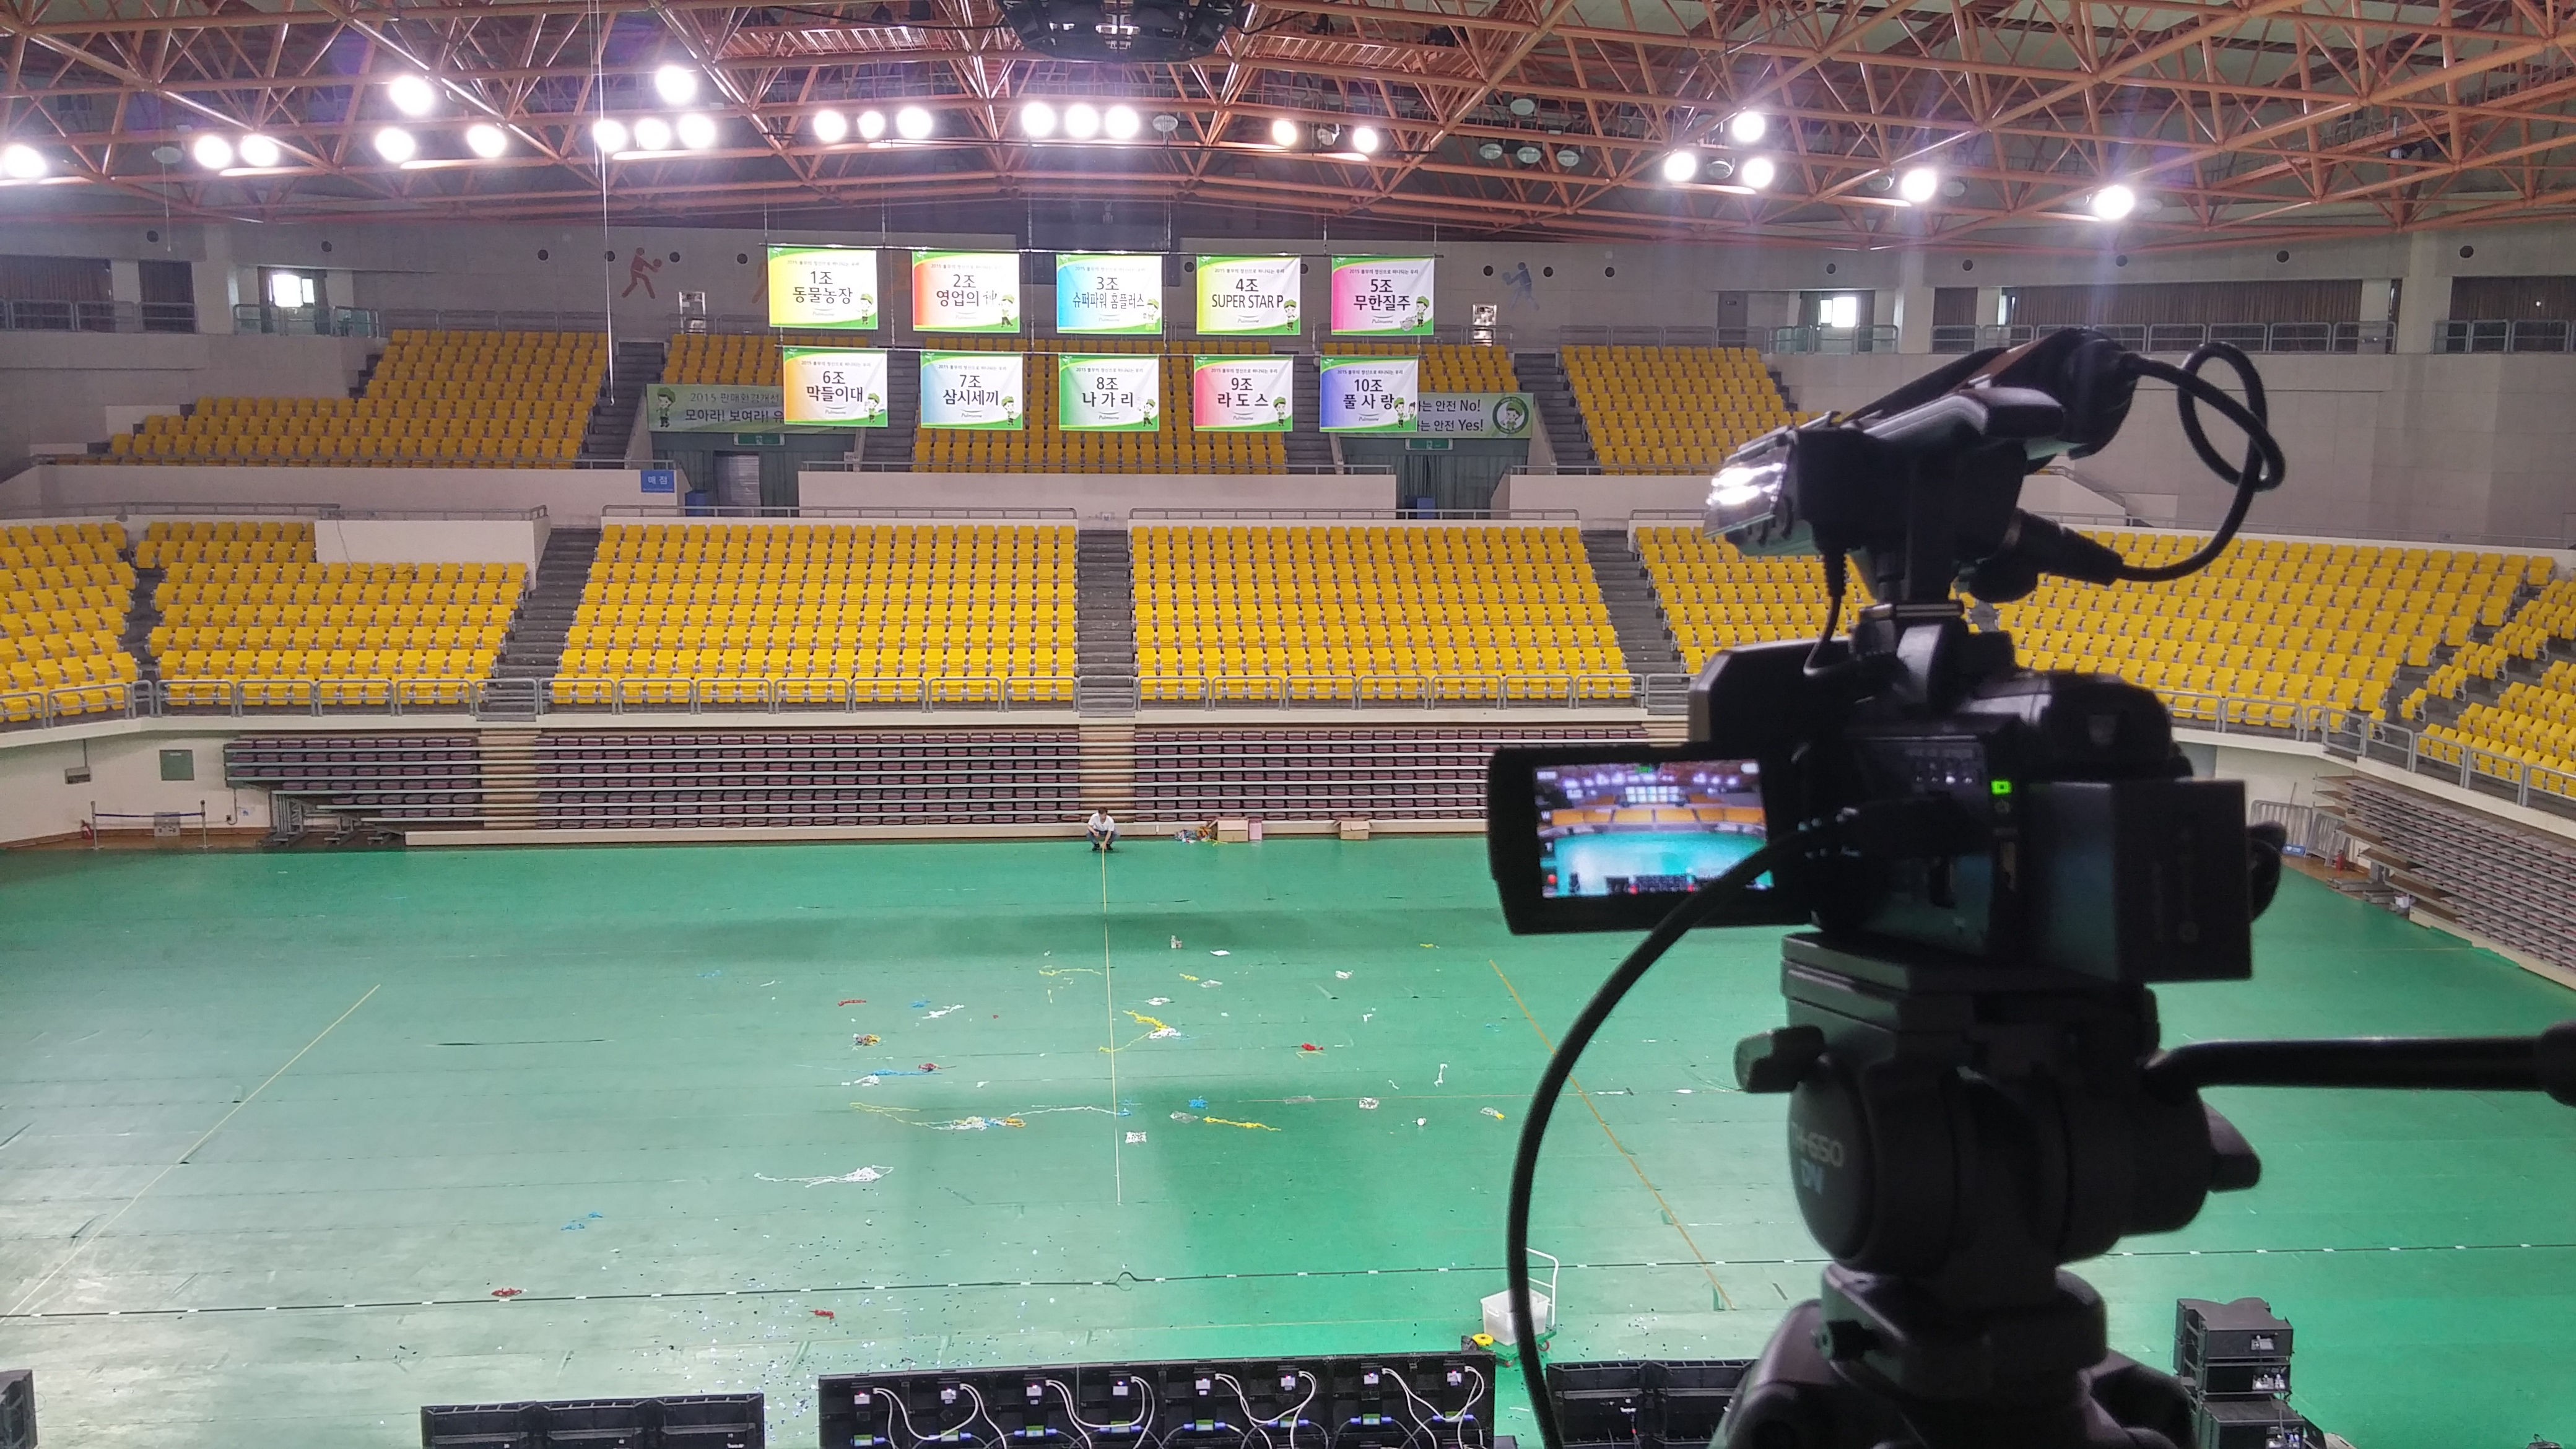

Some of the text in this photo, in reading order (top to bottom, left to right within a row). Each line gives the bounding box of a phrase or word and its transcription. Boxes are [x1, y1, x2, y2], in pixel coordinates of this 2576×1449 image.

[811, 271, 833, 284] 1조
[953, 274, 976, 287] 2조
[1097, 277, 1119, 290] 3조
[1236, 279, 1258, 292] 4조
[1370, 279, 1393, 292] 5조
[793, 287, 853, 304] 동물농장
[936, 290, 979, 307] 영업의
[1073, 292, 1144, 309] 슈퍼파워 홈플러스
[1212, 294, 1283, 308] SUPER STAR P
[1354, 295, 1411, 311] 무한질주
[823, 371, 845, 384] 6조
[960, 375, 981, 388] 7조
[1097, 377, 1118, 389] 8조
[1231, 378, 1253, 391] 9조
[1354, 379, 1383, 392] 10조
[690, 393, 716, 402] 2015
[806, 385, 863, 402] 막들이대
[942, 389, 998, 406] 삼시세끼
[1436, 401, 1455, 412] 안전
[1460, 399, 1480, 411] No!
[685, 409, 724, 422] 모아라!
[729, 410, 768, 423] 보여라!
[1434, 420, 1454, 431] 안전
[1458, 419, 1483, 432] Yes!
